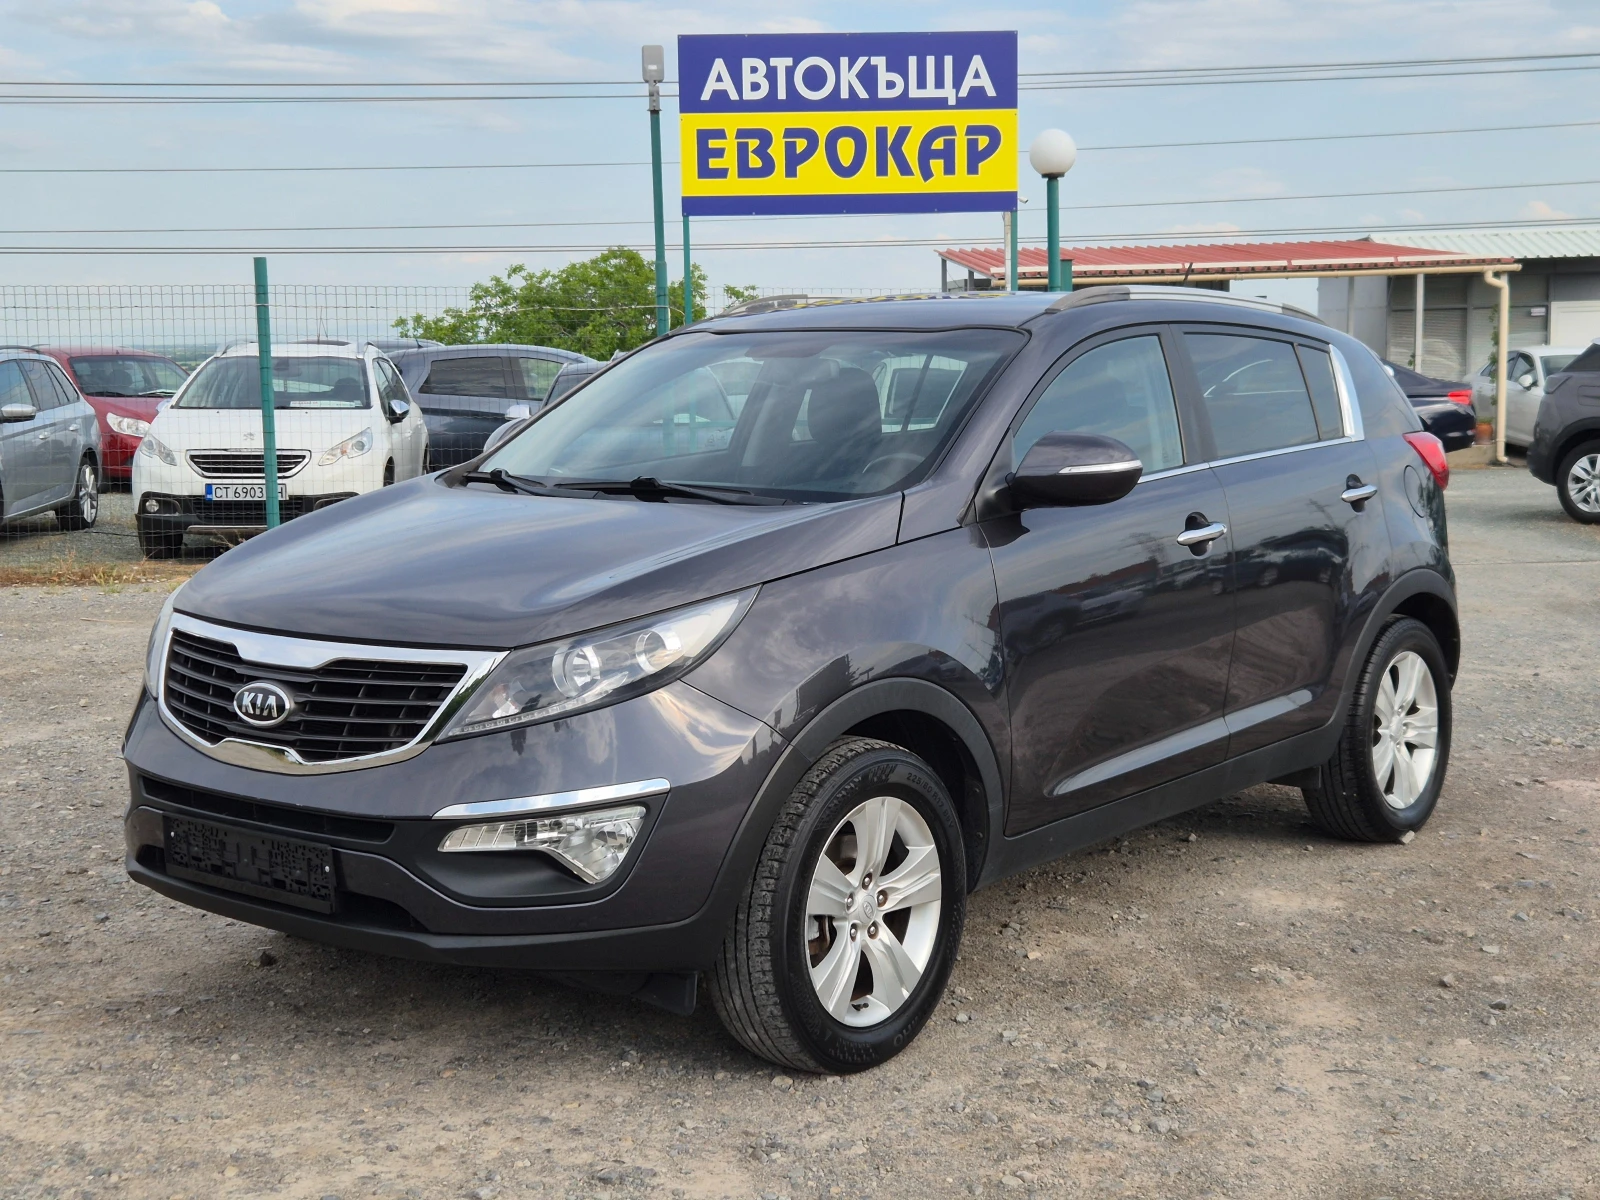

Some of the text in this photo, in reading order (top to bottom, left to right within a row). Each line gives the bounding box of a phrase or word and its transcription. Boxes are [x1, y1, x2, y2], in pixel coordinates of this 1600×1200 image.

[700, 54, 997, 106] АВТОКЪЩА
[695, 124, 1003, 183] ЕВРОКАР
[214, 486, 231, 499] CT
[233, 486, 264, 499] 6903
[241, 691, 278, 718] KIA
